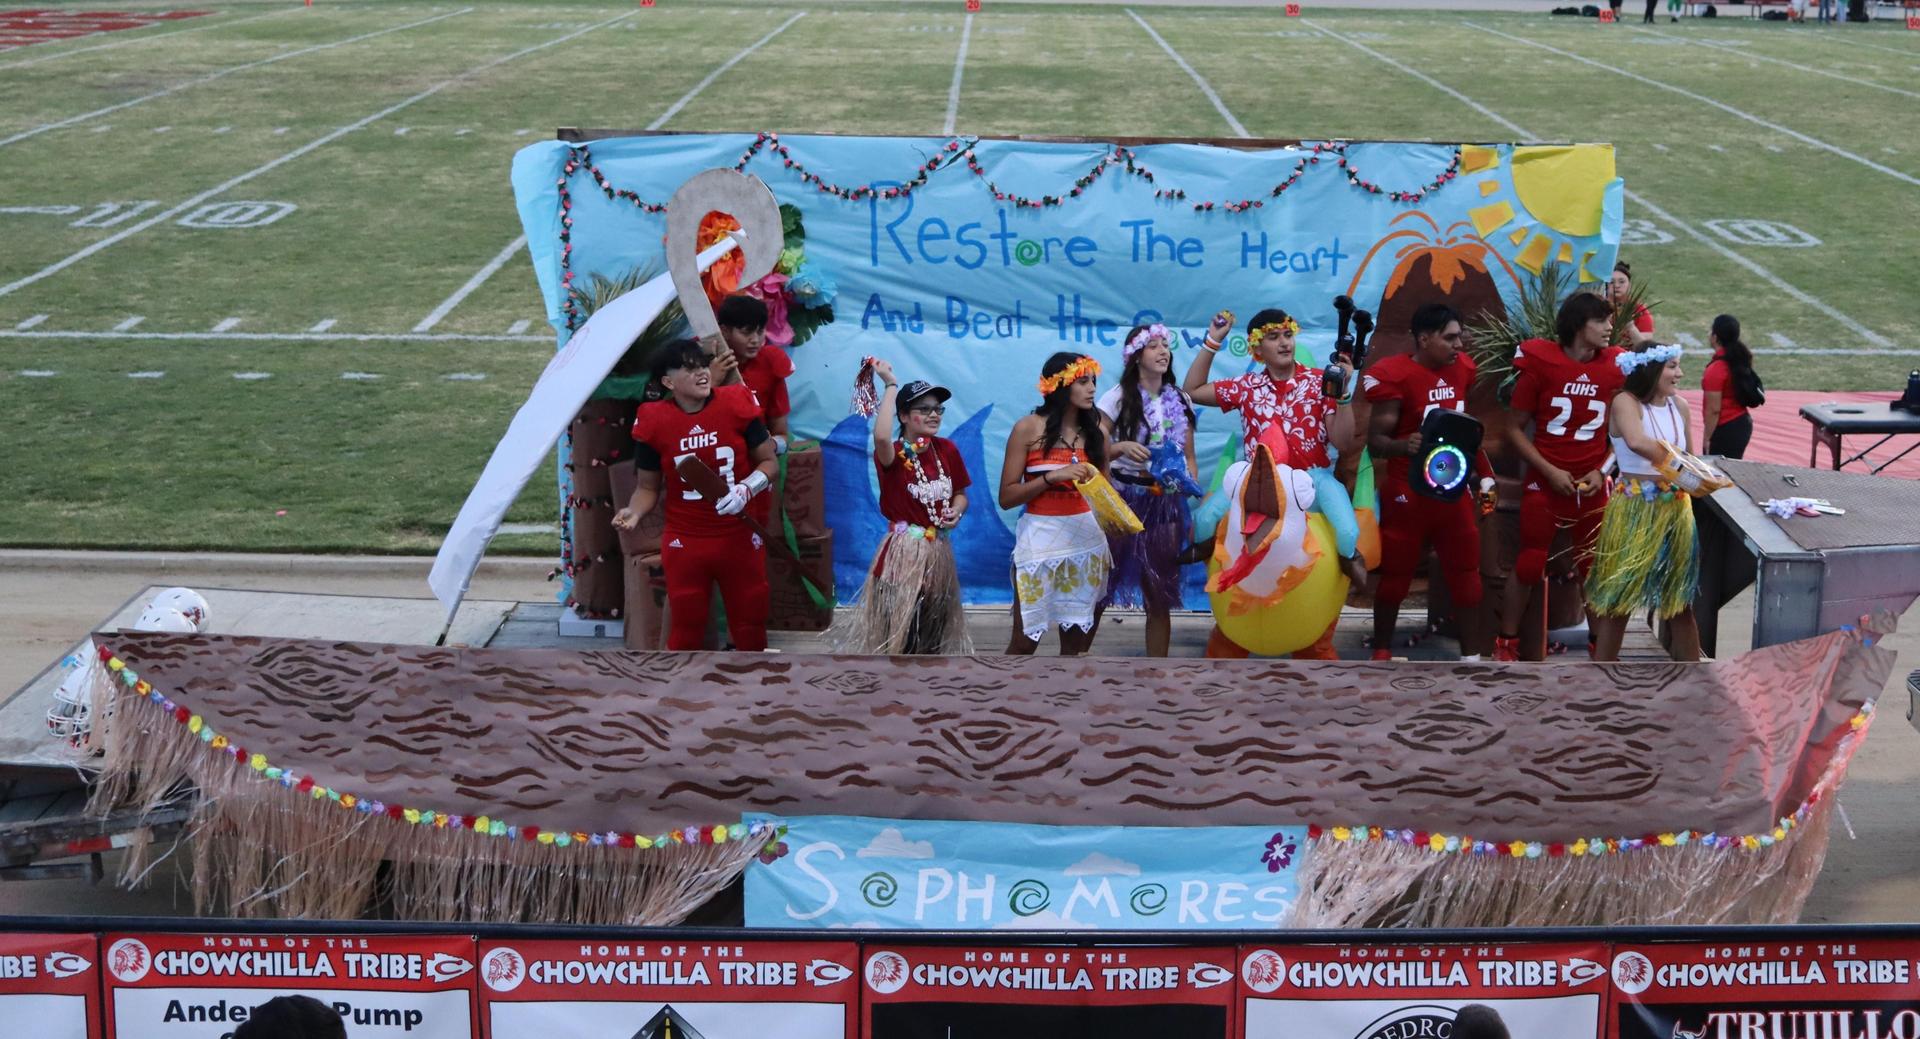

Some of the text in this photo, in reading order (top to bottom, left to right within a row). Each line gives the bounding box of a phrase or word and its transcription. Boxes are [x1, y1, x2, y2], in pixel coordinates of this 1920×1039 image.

[869, 180, 1349, 277] Restore The Heart
[861, 293, 924, 335] And
[946, 295, 1030, 340] Beat
[1050, 294, 1118, 347] the
[1428, 386, 1455, 402] CUHS
[1562, 382, 1599, 397] CUHS
[1546, 396, 1606, 441] 22
[680, 432, 718, 451] CUHS
[204, 937, 369, 949] HOME OF THE
[581, 946, 744, 957] HOME OF THE
[1340, 947, 1504, 957] HOME OF THE
[1705, 944, 1857, 958] HOME OF THE
[153, 951, 336, 977] CHOWCHILLA
[344, 954, 422, 981] TRIBE
[965, 952, 1128, 963] HOME OF THE
[529, 961, 711, 985] CHOWCHILLA
[719, 962, 798, 986] TRIBE
[912, 964, 1095, 991] CHOWCHILLA
[1100, 966, 1179, 990] TRIBE
[1288, 961, 1471, 987] CHOWCHILLA
[1478, 961, 1557, 987] TRIBE
[1656, 959, 1910, 987] CHOWCHILLA TRIBE
[163, 1000, 257, 1022] Ande
